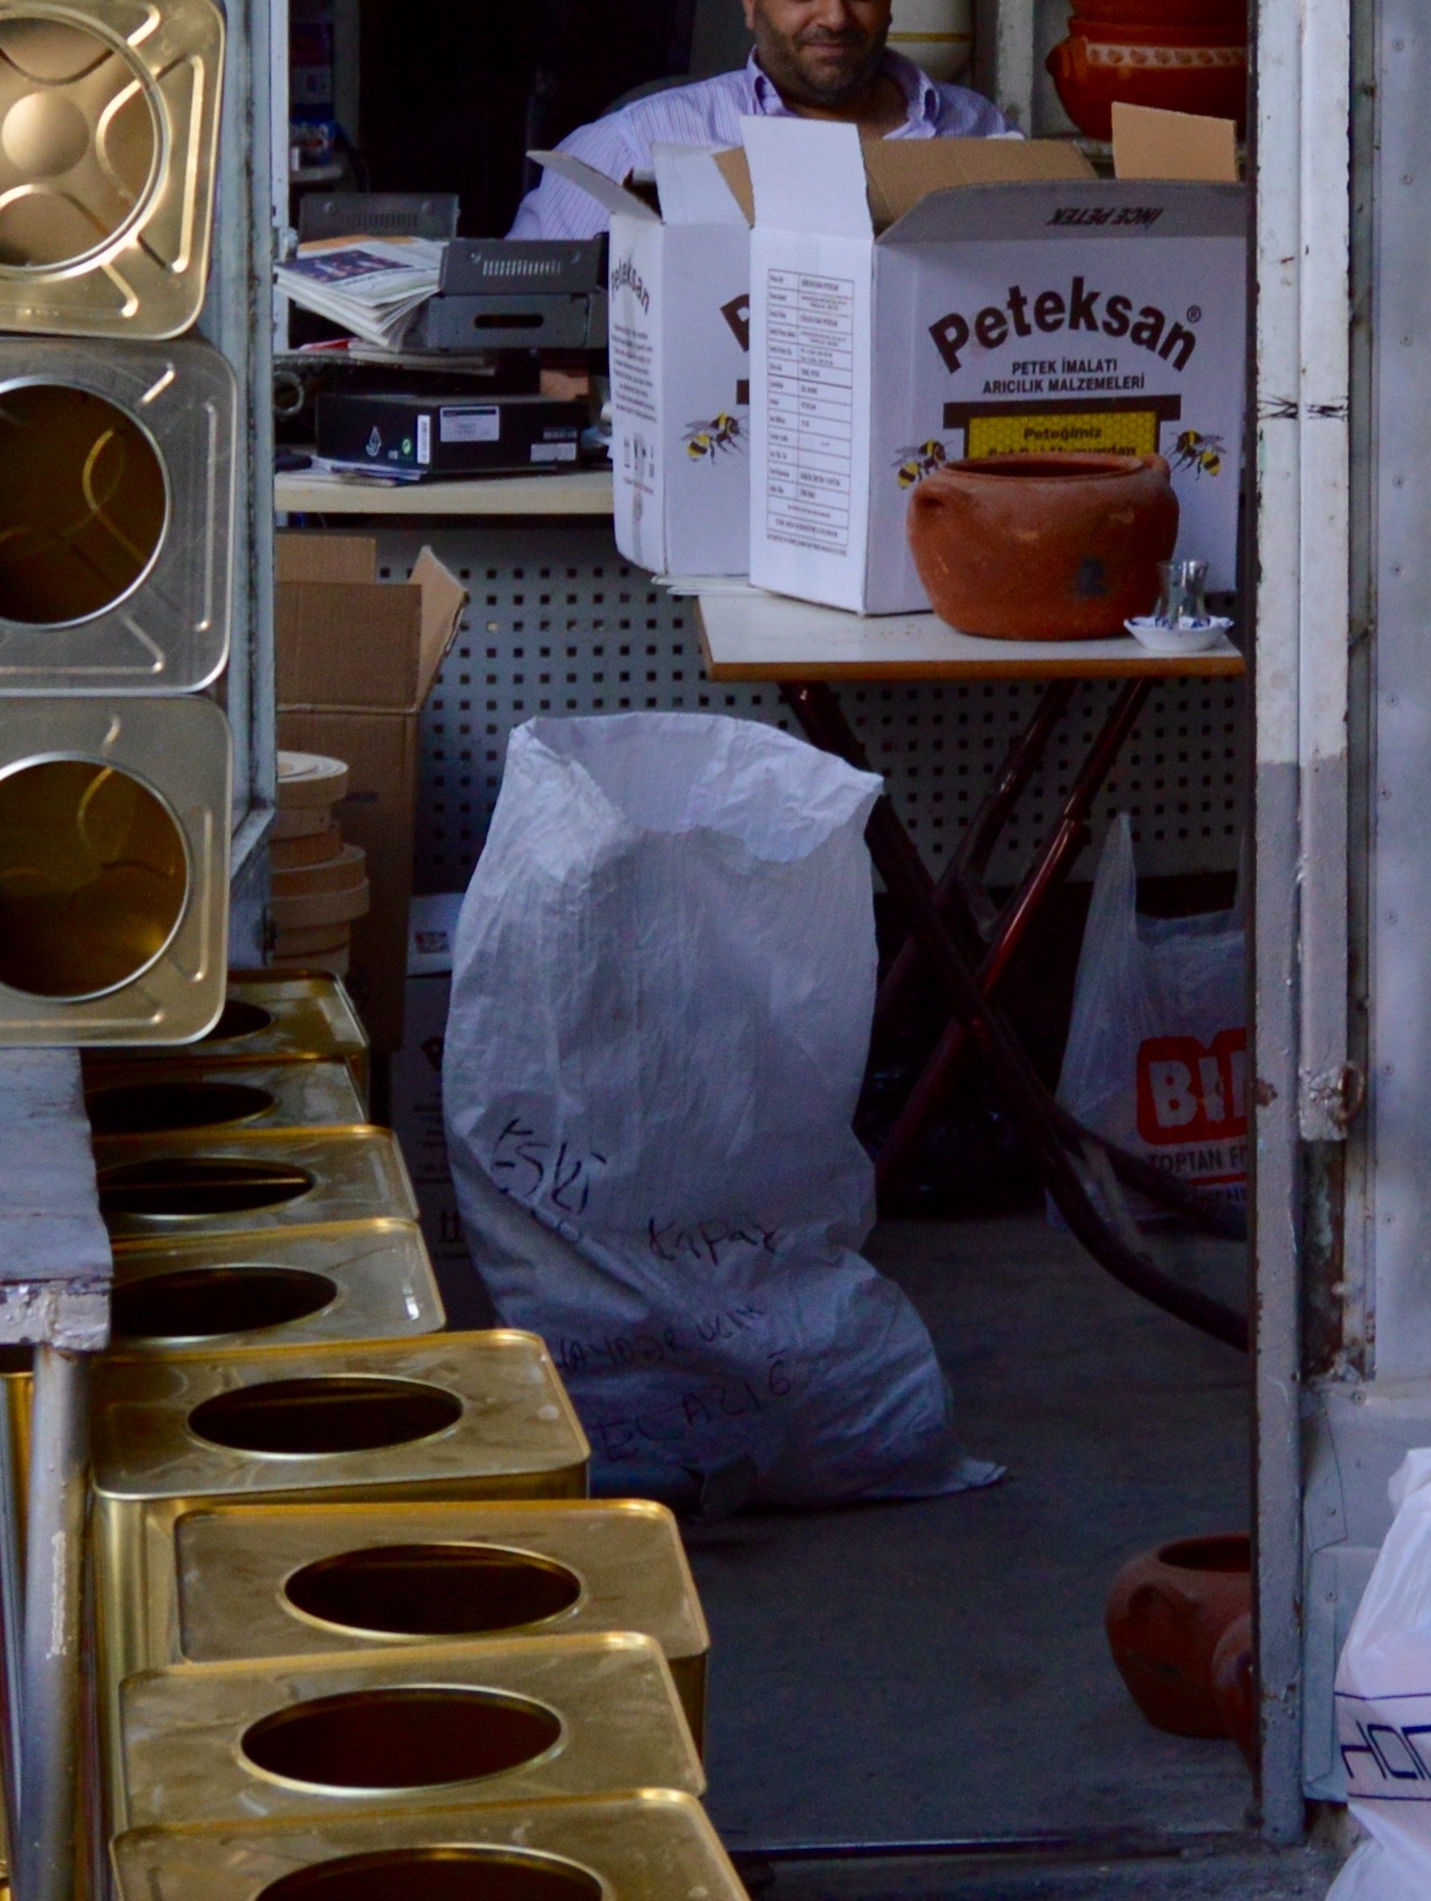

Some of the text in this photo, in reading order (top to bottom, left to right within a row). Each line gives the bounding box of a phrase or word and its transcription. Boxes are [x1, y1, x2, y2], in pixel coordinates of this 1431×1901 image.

[929, 276, 1197, 374] Peteksan
[1012, 356, 1118, 376] PETEK İMALATI
[982, 372, 1145, 394] ARICILIK MALZEMELERİ
